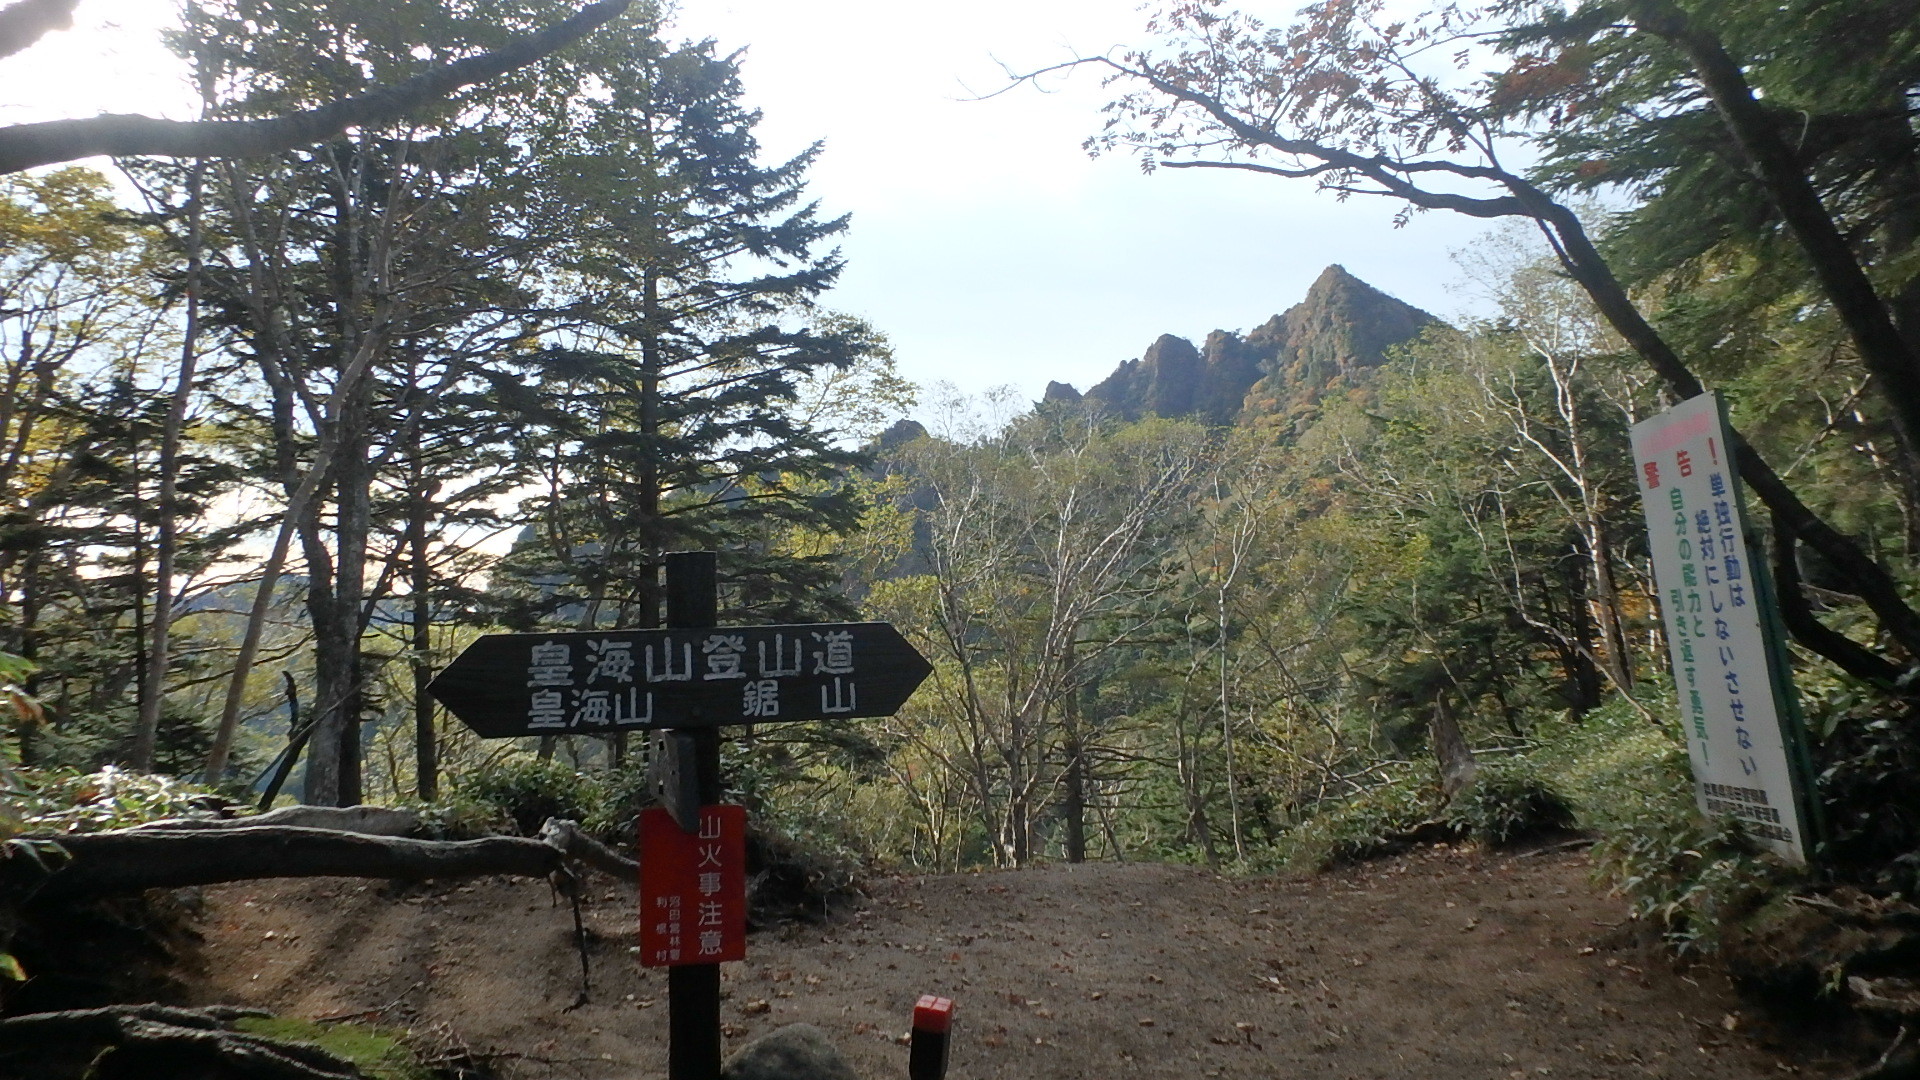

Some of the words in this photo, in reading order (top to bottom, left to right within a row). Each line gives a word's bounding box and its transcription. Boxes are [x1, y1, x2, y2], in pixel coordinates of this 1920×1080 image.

[1670, 487, 1706, 638] 自分の能力と
[1709, 472, 1746, 608] 単独行動は
[527, 630, 855, 688] 皇海山登山道
[527, 687, 653, 729] 皇海山
[742, 677, 856, 717] 鋸山
[1695, 509, 1757, 776] 絶対にしないさせない
[698, 815, 723, 955] 山火事注意
